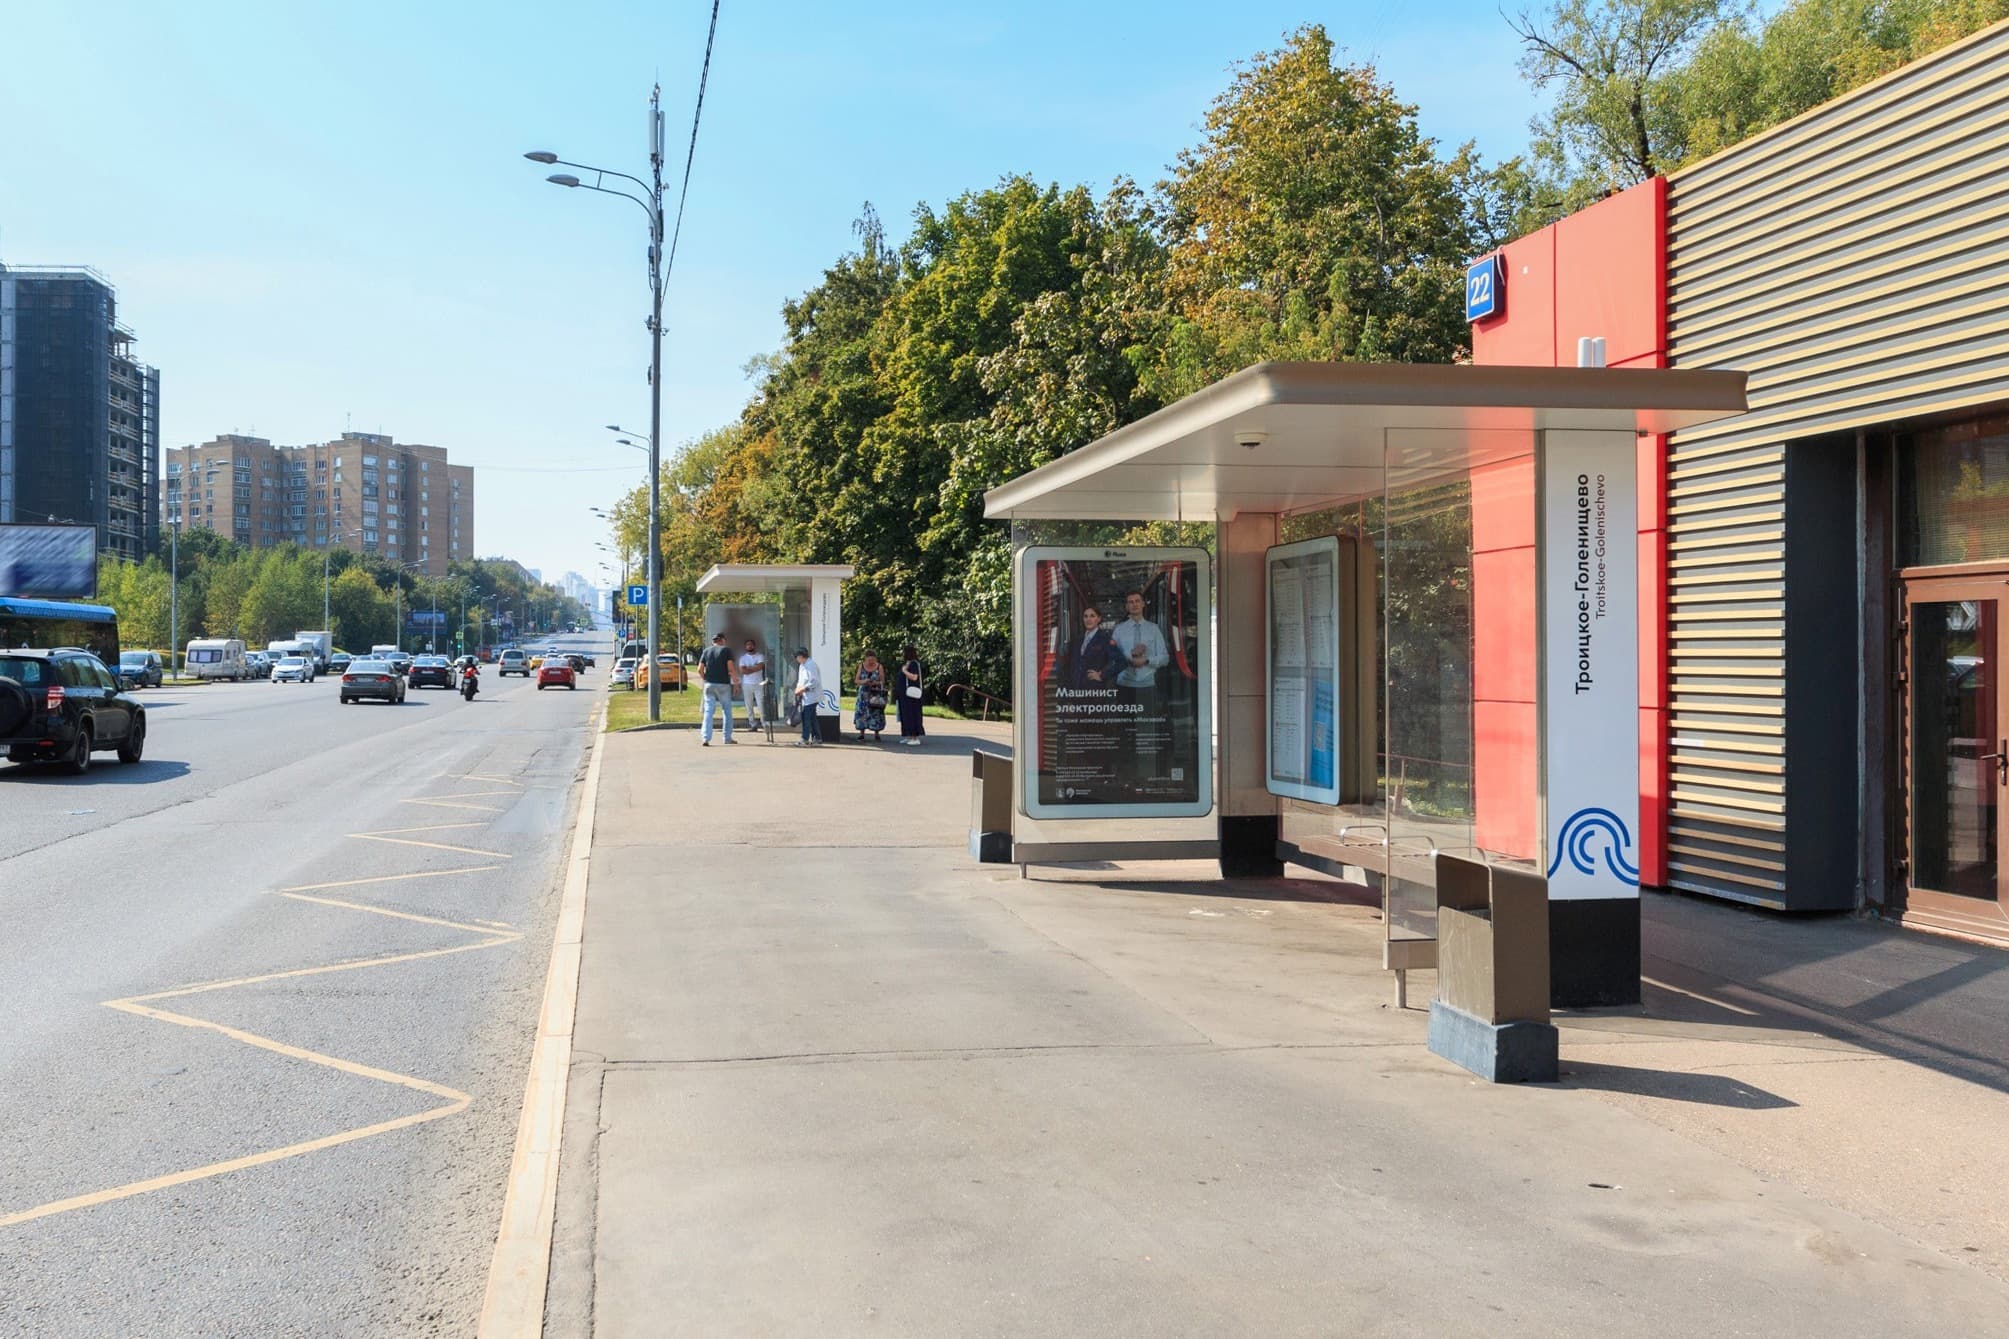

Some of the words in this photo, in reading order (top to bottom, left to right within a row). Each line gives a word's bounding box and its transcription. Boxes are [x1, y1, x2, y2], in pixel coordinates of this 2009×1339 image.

[1470, 272, 1490, 307] 22
[1594, 473, 1606, 620] Troitskoe-Golenischevo
[633, 587, 644, 604] P
[1574, 473, 1593, 695] Троицкое-Голенищево
[1055, 687, 1119, 698] Машинист
[1055, 703, 1144, 715] электропоезда
